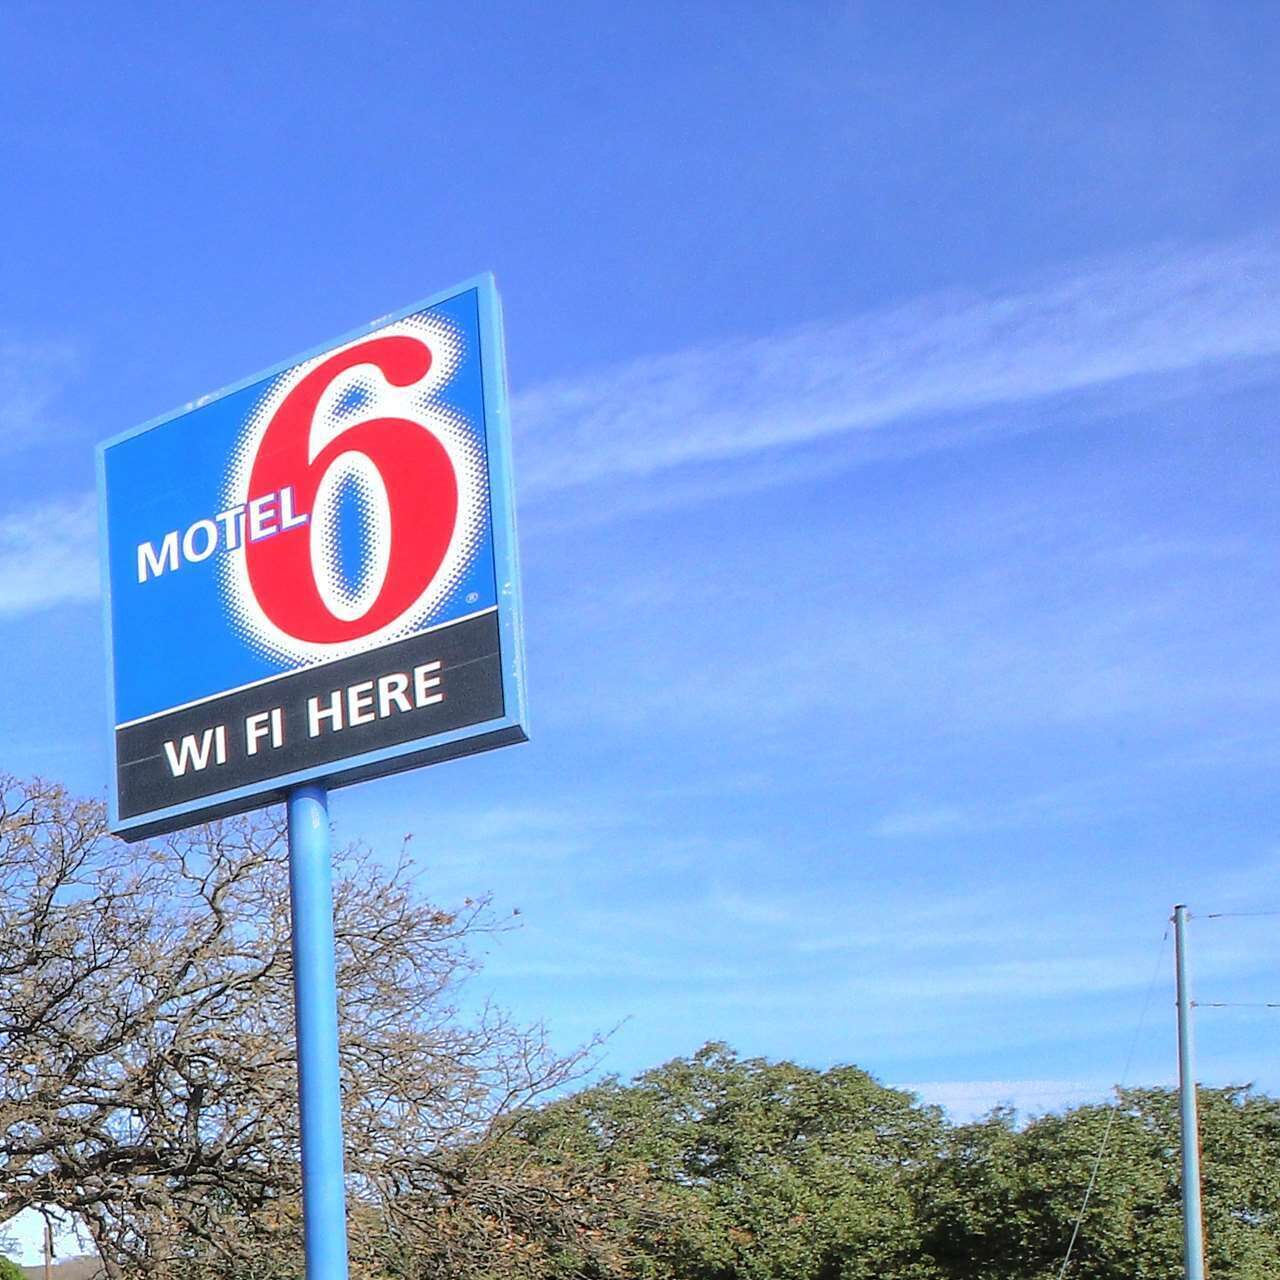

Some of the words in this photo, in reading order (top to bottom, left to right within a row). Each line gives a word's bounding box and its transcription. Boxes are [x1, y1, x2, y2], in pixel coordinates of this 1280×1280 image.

[136, 486, 309, 584] MOTEL
[244, 334, 458, 644] 6
[163, 725, 227, 777] WI
[246, 710, 283, 756] FI
[307, 660, 444, 738] HERE
